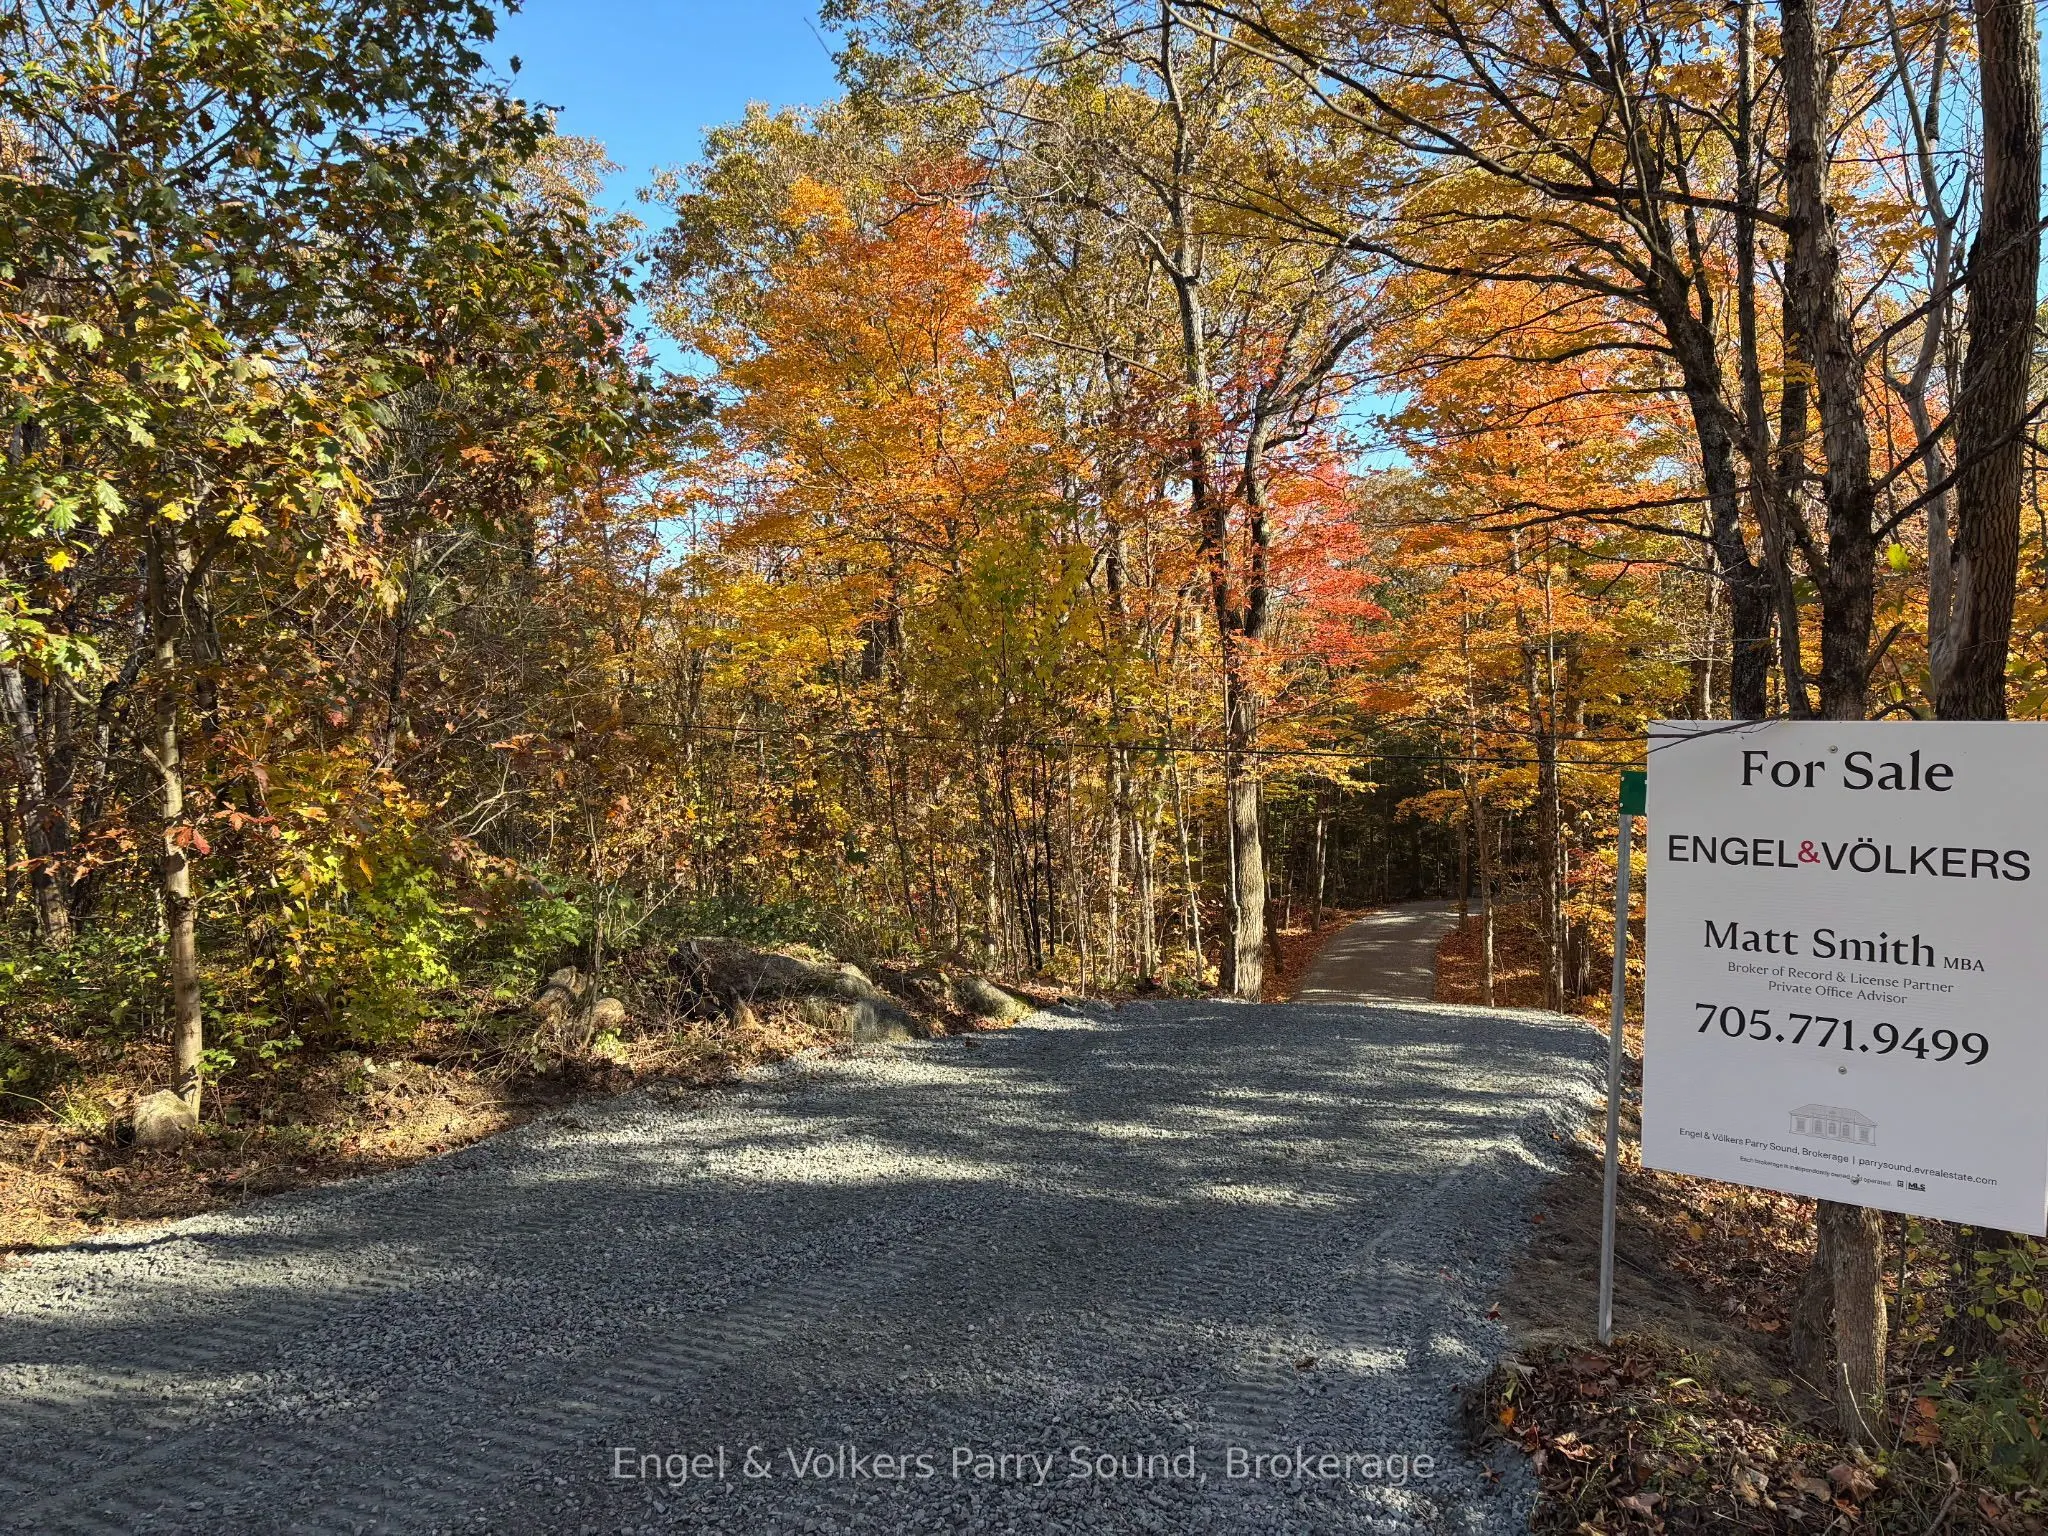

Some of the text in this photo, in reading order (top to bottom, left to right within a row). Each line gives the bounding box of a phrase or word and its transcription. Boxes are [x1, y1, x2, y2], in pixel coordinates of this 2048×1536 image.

[1741, 749, 1954, 792] For Sale
[1704, 919, 1985, 972] Matt Smith MBA
[1728, 961, 1954, 993] Broker of Record & License Partner
[1768, 980, 1908, 1004] Private Office Advisor
[1695, 1002, 1989, 1066] 705.771.9499
[1679, 1127, 1703, 1139] Engel
[1704, 1131, 1711, 1140] &
[1745, 1139, 1768, 1150] Parry
[1769, 1143, 1800, 1155] Sound,
[1802, 1147, 1849, 1163] Brokerage
[1858, 1157, 1998, 1186] parrysound.evrealestate.com
